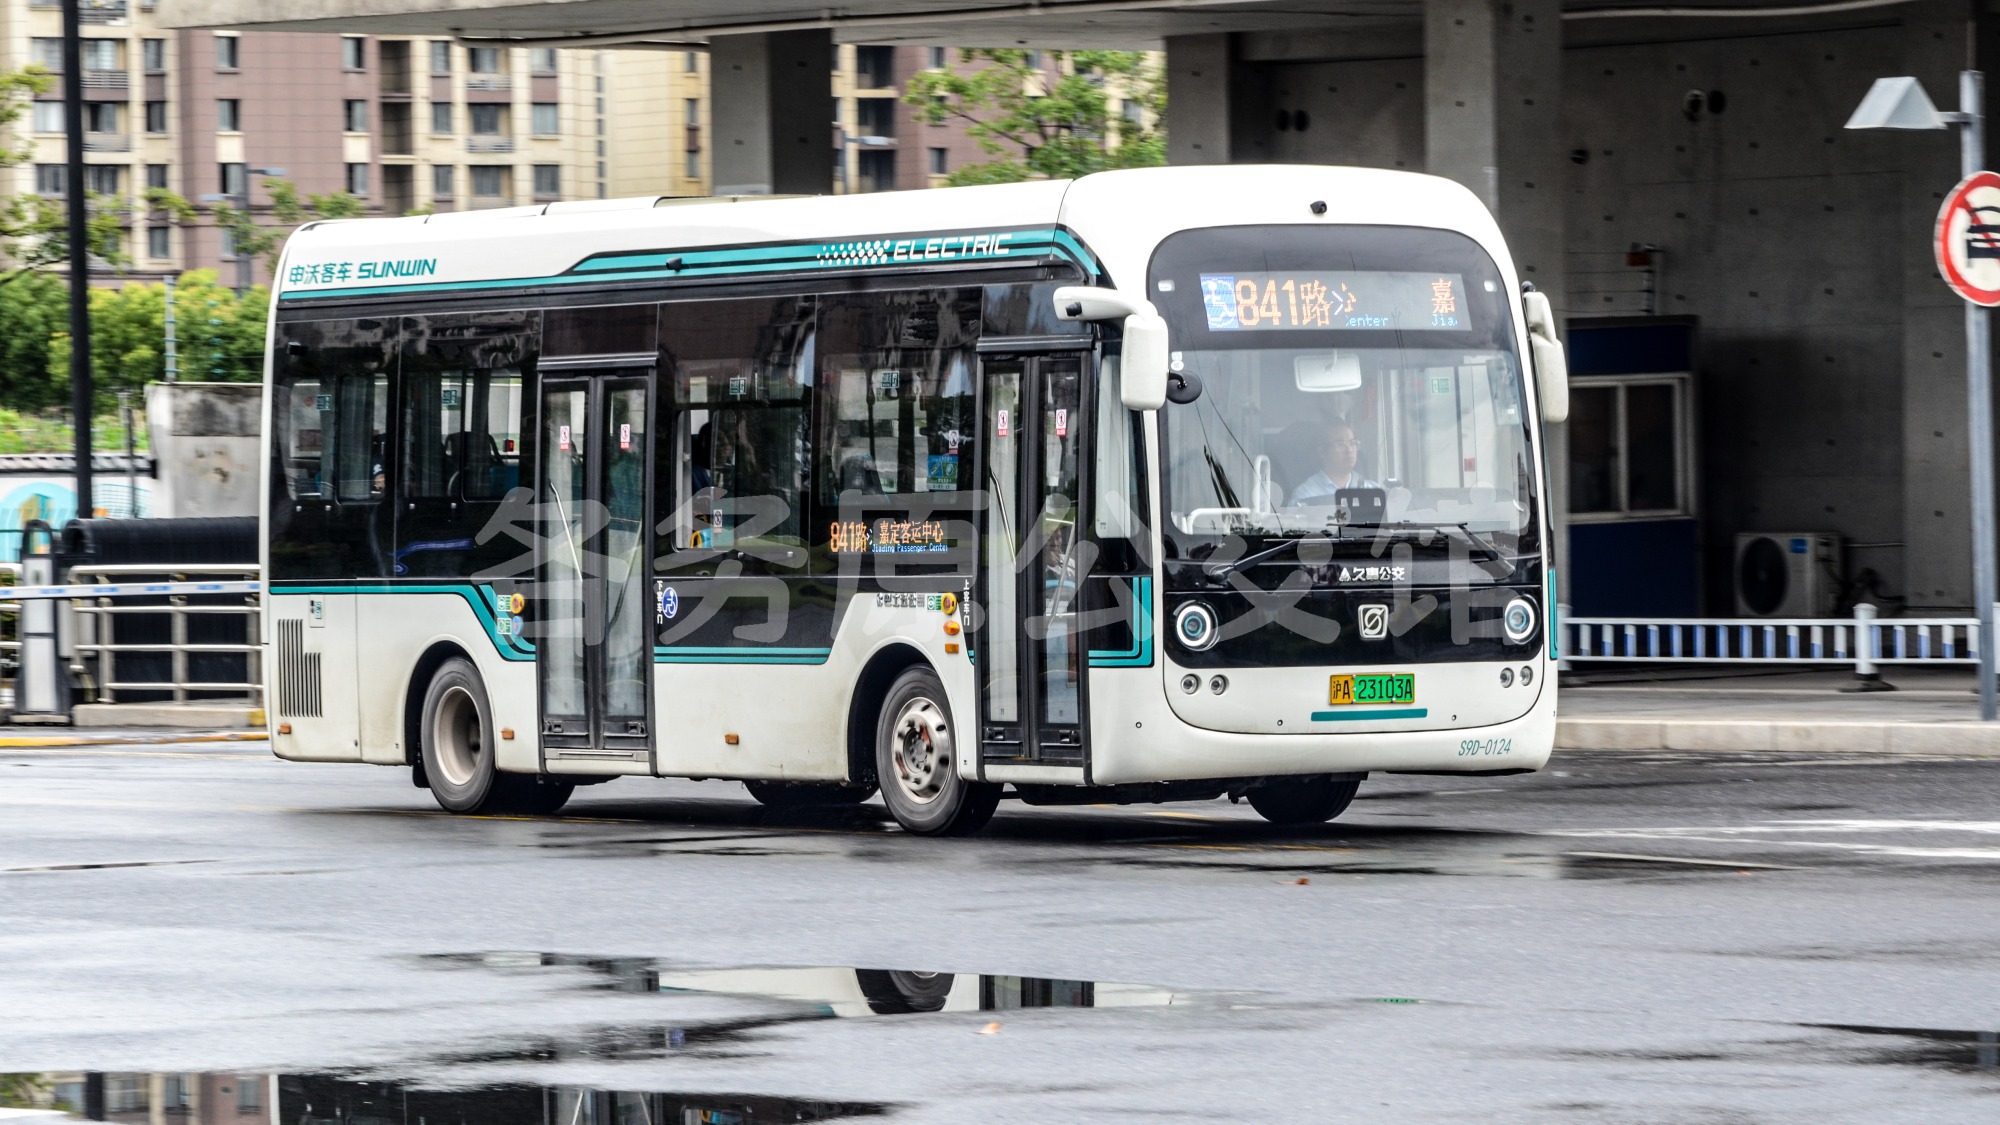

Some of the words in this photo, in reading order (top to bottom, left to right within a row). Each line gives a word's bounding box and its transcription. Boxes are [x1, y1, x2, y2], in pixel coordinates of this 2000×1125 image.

[893, 233, 1012, 261] ELECTRIC
[289, 261, 353, 285] 申沃客车
[357, 258, 437, 279] SUNWIN
[1235, 279, 1332, 327] 841路
[1431, 278, 1456, 314] 嘉
[879, 520, 944, 544] 嘉定客运中心
[1458, 738, 1512, 756] S9D-0124
